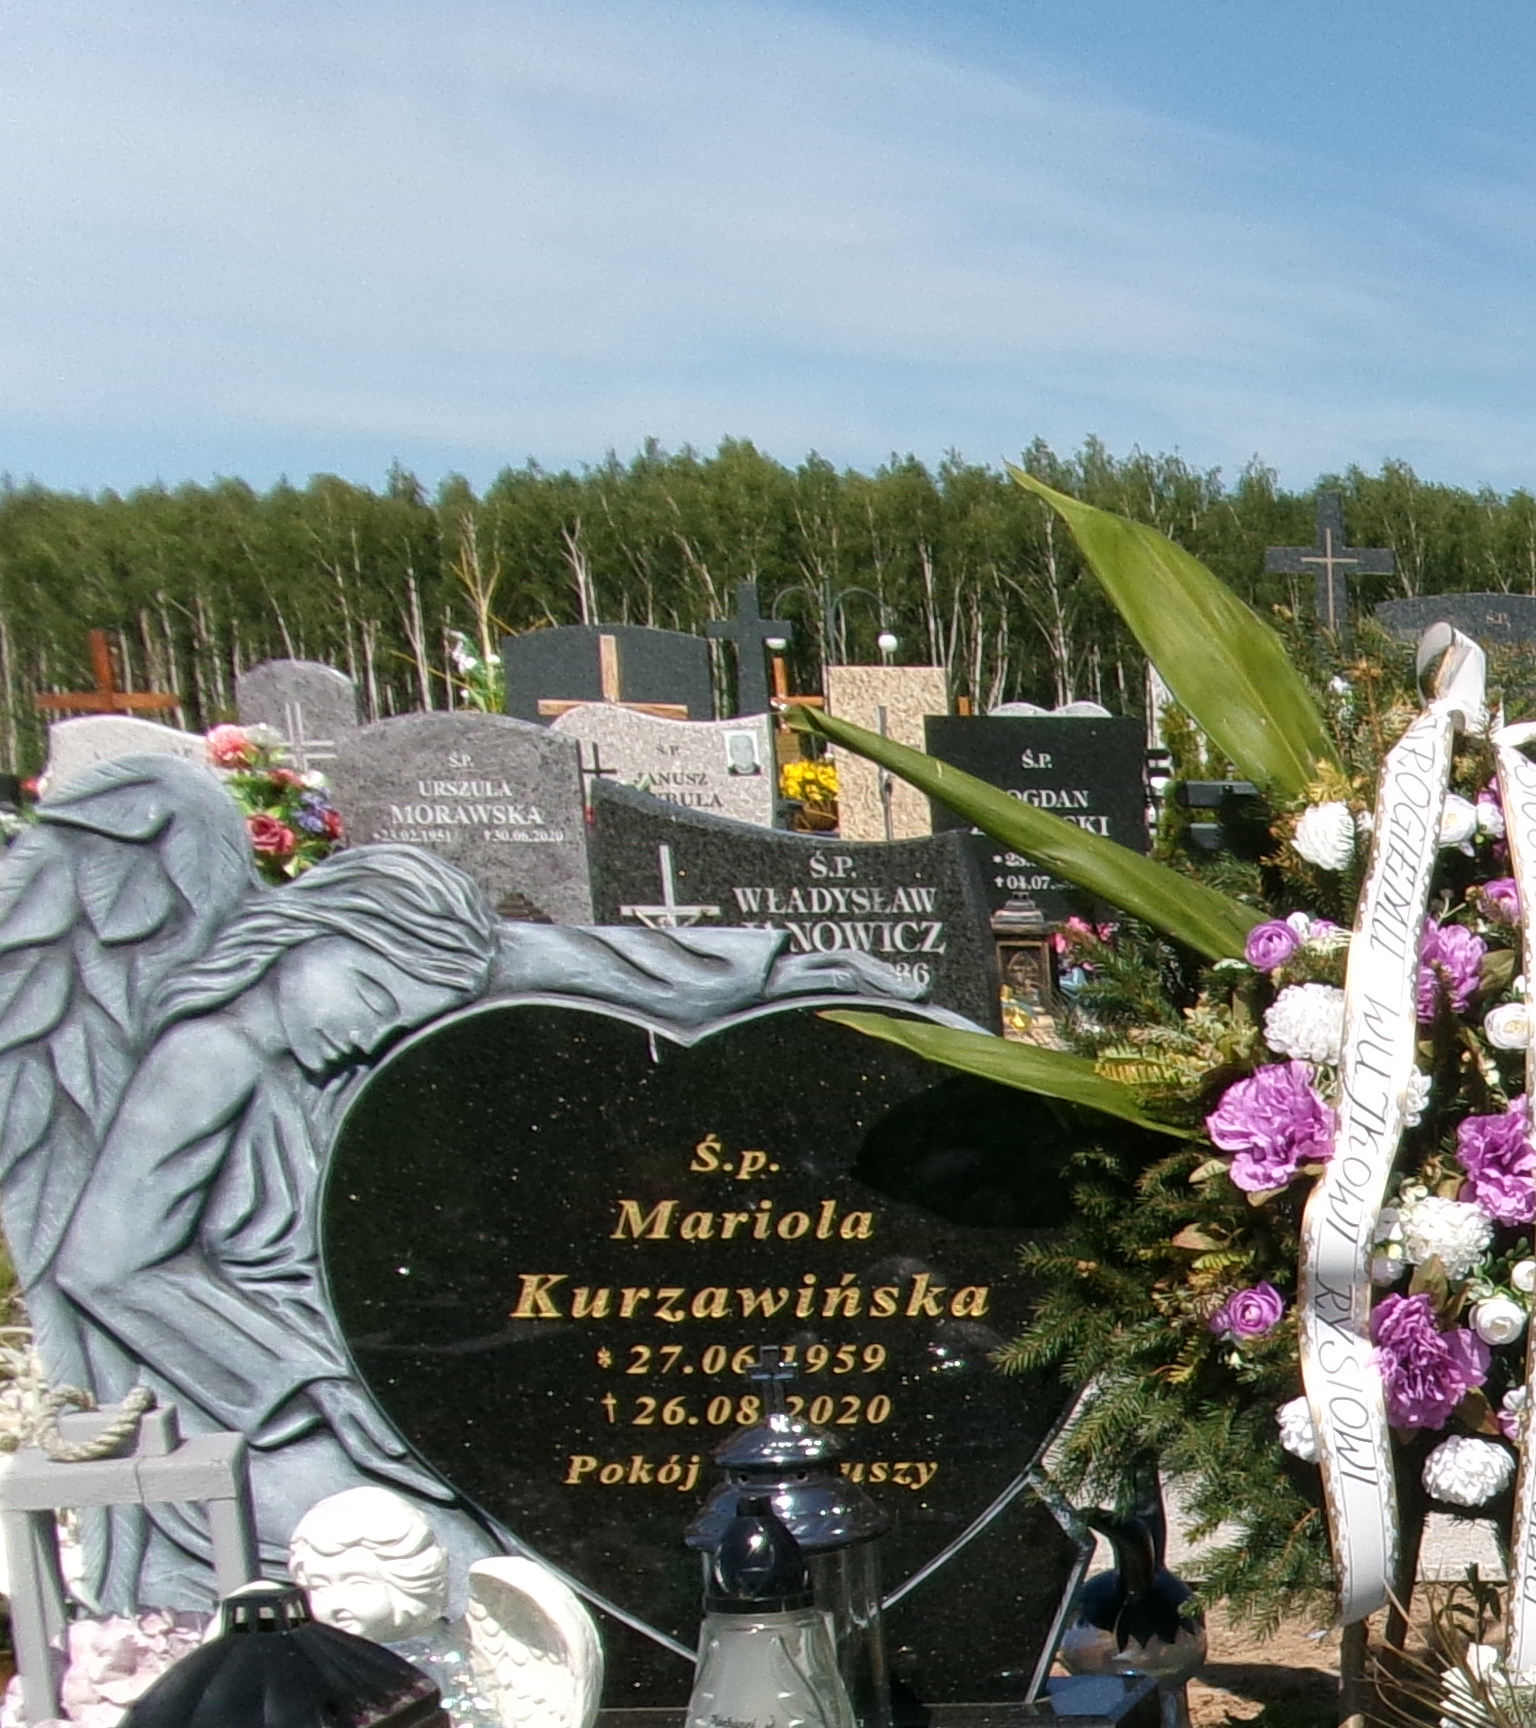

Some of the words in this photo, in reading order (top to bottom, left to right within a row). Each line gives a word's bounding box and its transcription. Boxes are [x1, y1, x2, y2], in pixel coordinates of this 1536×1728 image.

[1021, 748, 1053, 769] Ś.P.
[418, 779, 513, 797] URSZULA
[390, 803, 545, 825] MORAWSKA
[809, 850, 858, 879] Ś.P.
[732, 886, 937, 915] WŁADYSŁAW
[689, 1133, 781, 1181] Ś.p.
[610, 1199, 875, 1241] Mariola
[510, 1272, 991, 1322] Kurzawińska
[565, 1455, 702, 1492] Pokój
[838, 1459, 940, 1491] uszy
